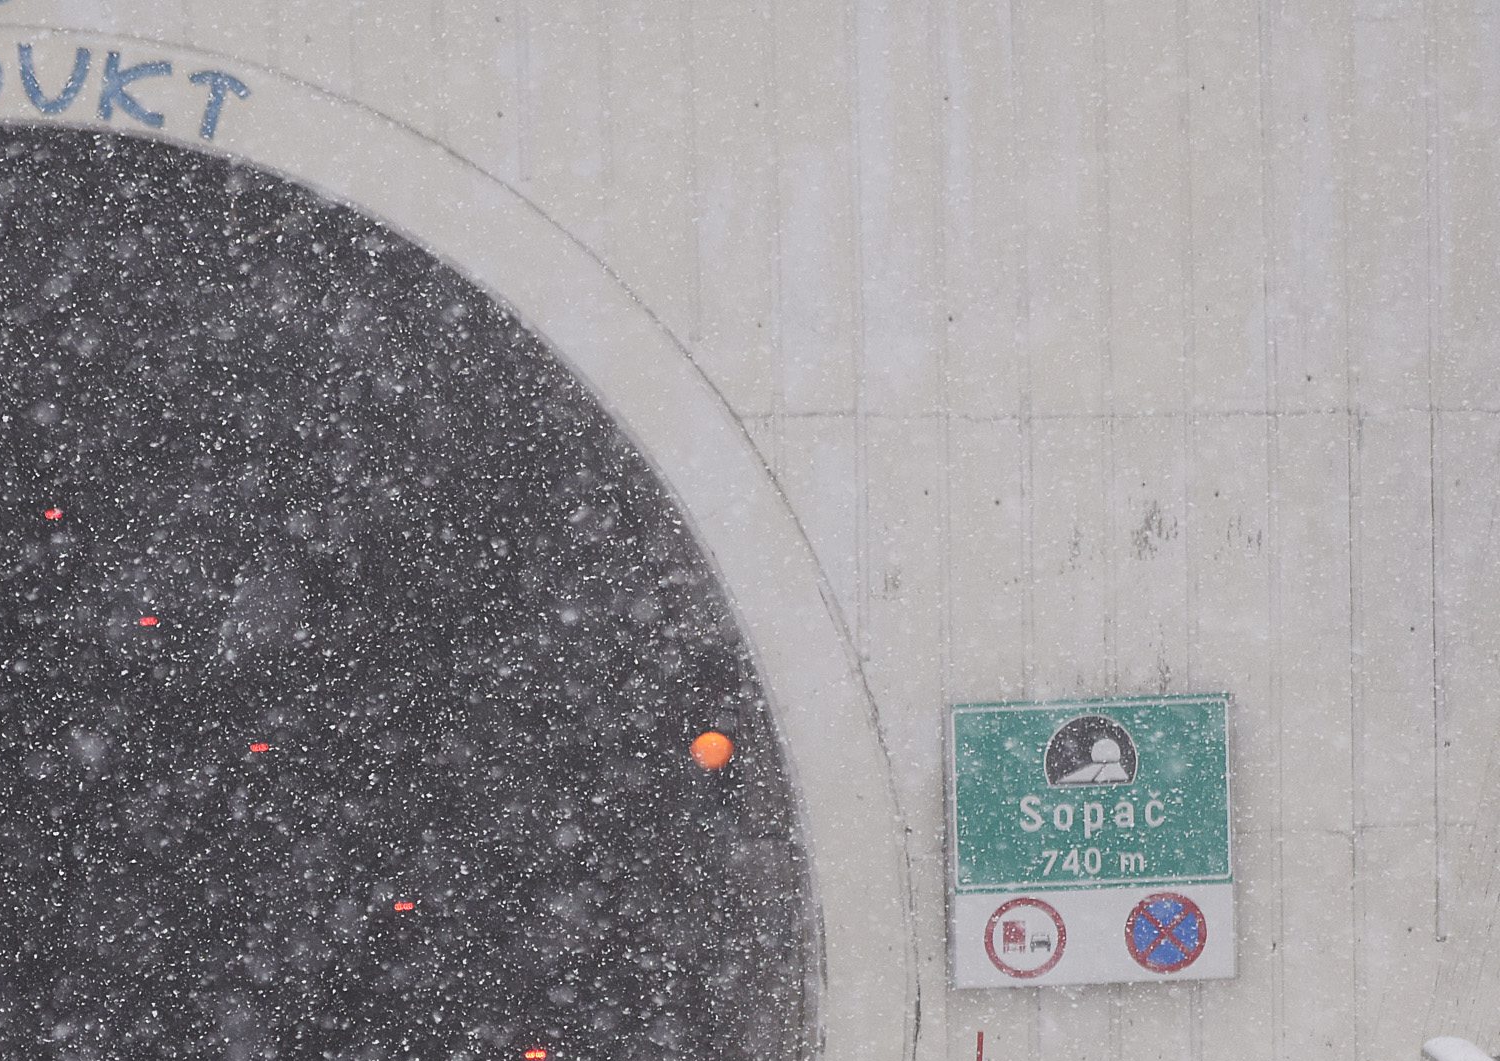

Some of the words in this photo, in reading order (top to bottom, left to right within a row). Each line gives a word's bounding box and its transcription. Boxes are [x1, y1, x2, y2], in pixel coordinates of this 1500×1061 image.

[1019, 790, 1166, 839] Sopač
[1041, 847, 1102, 876] 740
[1119, 850, 1145, 872] m
